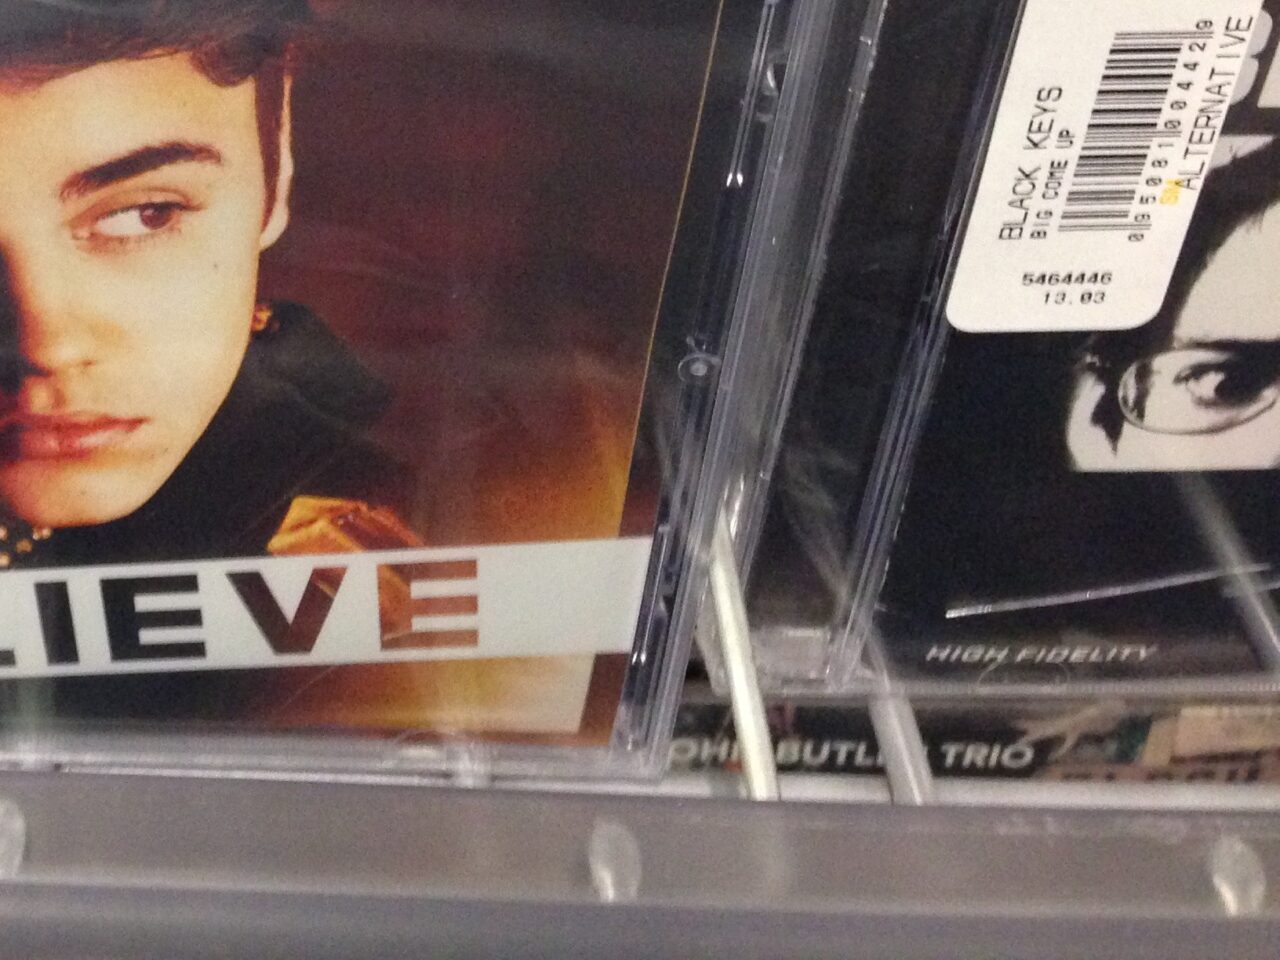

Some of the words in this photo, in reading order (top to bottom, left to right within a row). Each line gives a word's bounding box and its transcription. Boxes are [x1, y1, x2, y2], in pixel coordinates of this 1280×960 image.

[1175, 15, 1254, 191] ALTERNATIVE
[999, 165, 1042, 240] BLACK
[1023, 86, 1062, 151] KEYS
[1029, 208, 1053, 239] BIG
[1041, 158, 1068, 200] COME
[1058, 127, 1075, 149] UP
[1021, 271, 1113, 287] 5464446
[1043, 291, 1106, 306] 13.03
[925, 644, 1011, 664] HIGH
[1016, 644, 1158, 664] FIDELITY
[939, 741, 1035, 770] TRIO
